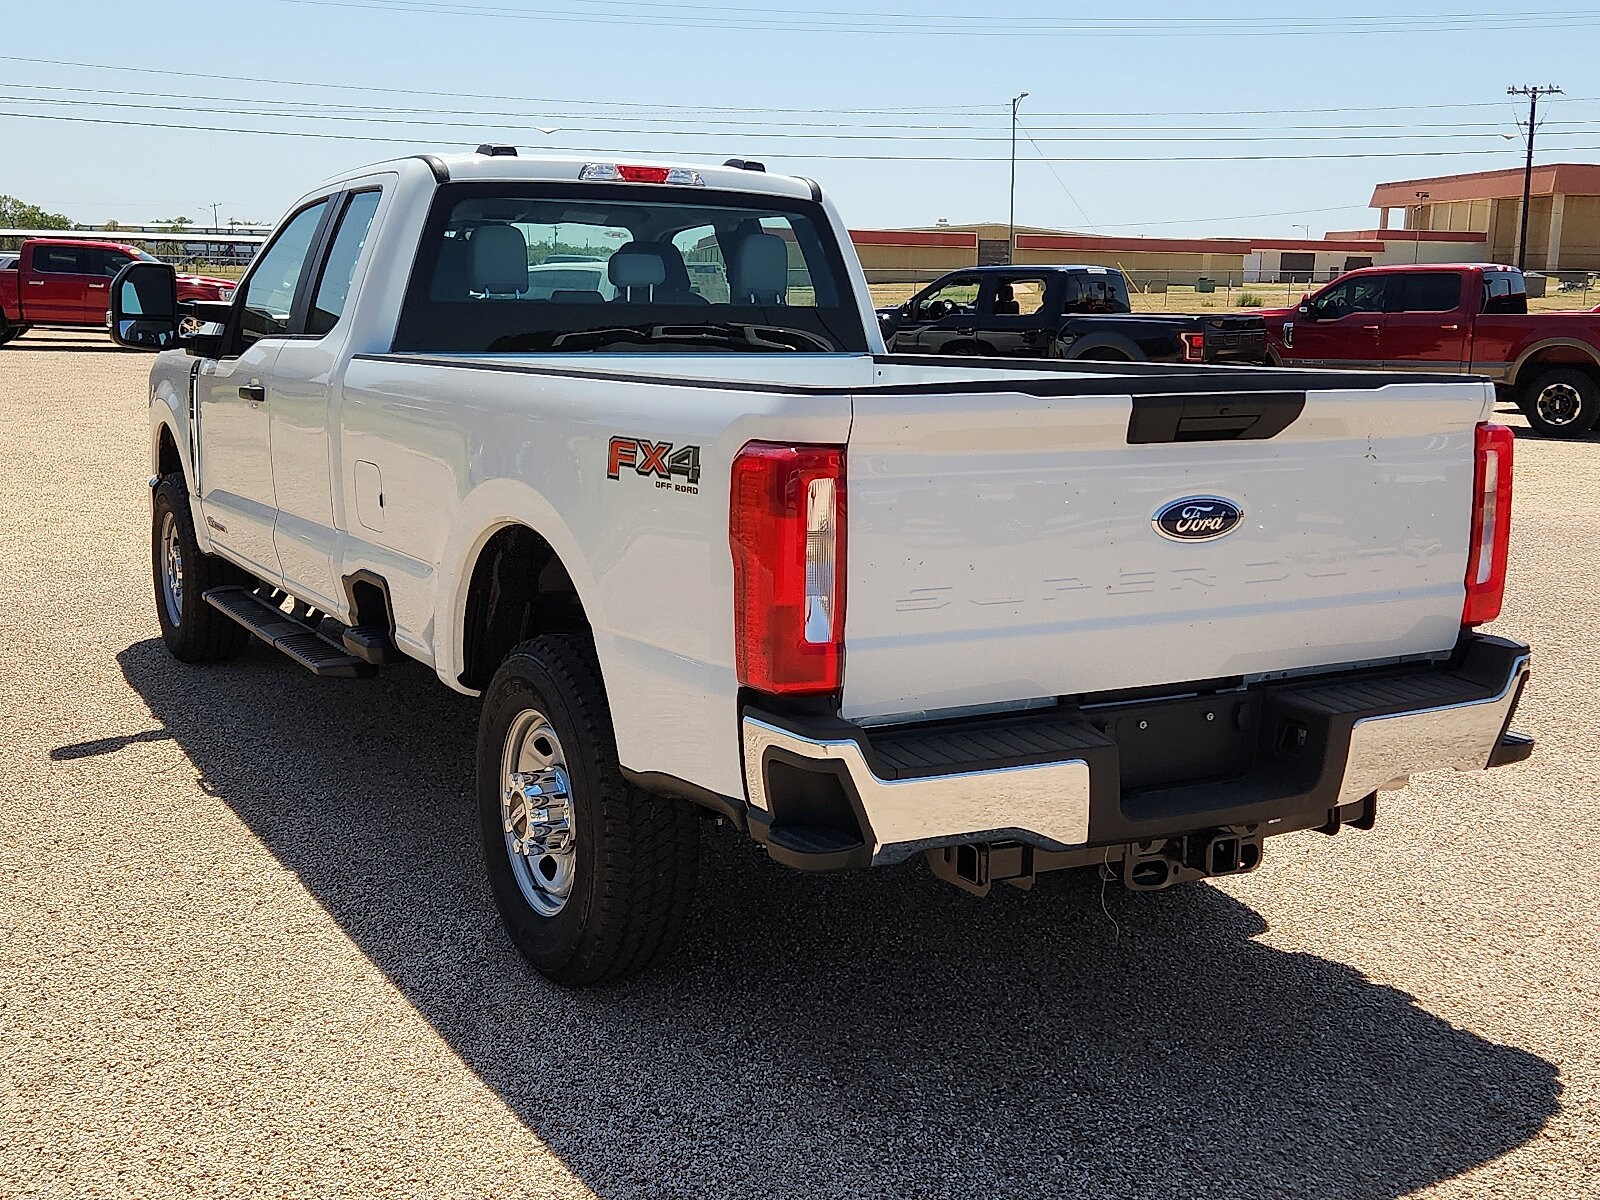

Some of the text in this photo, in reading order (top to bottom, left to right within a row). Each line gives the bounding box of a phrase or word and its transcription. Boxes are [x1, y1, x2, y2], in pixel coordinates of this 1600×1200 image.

[607, 435, 700, 485] FX4
[655, 481, 698, 495] OFF ROAD
[1176, 506, 1225, 532] Ford
[895, 567, 1217, 612] SUPER
